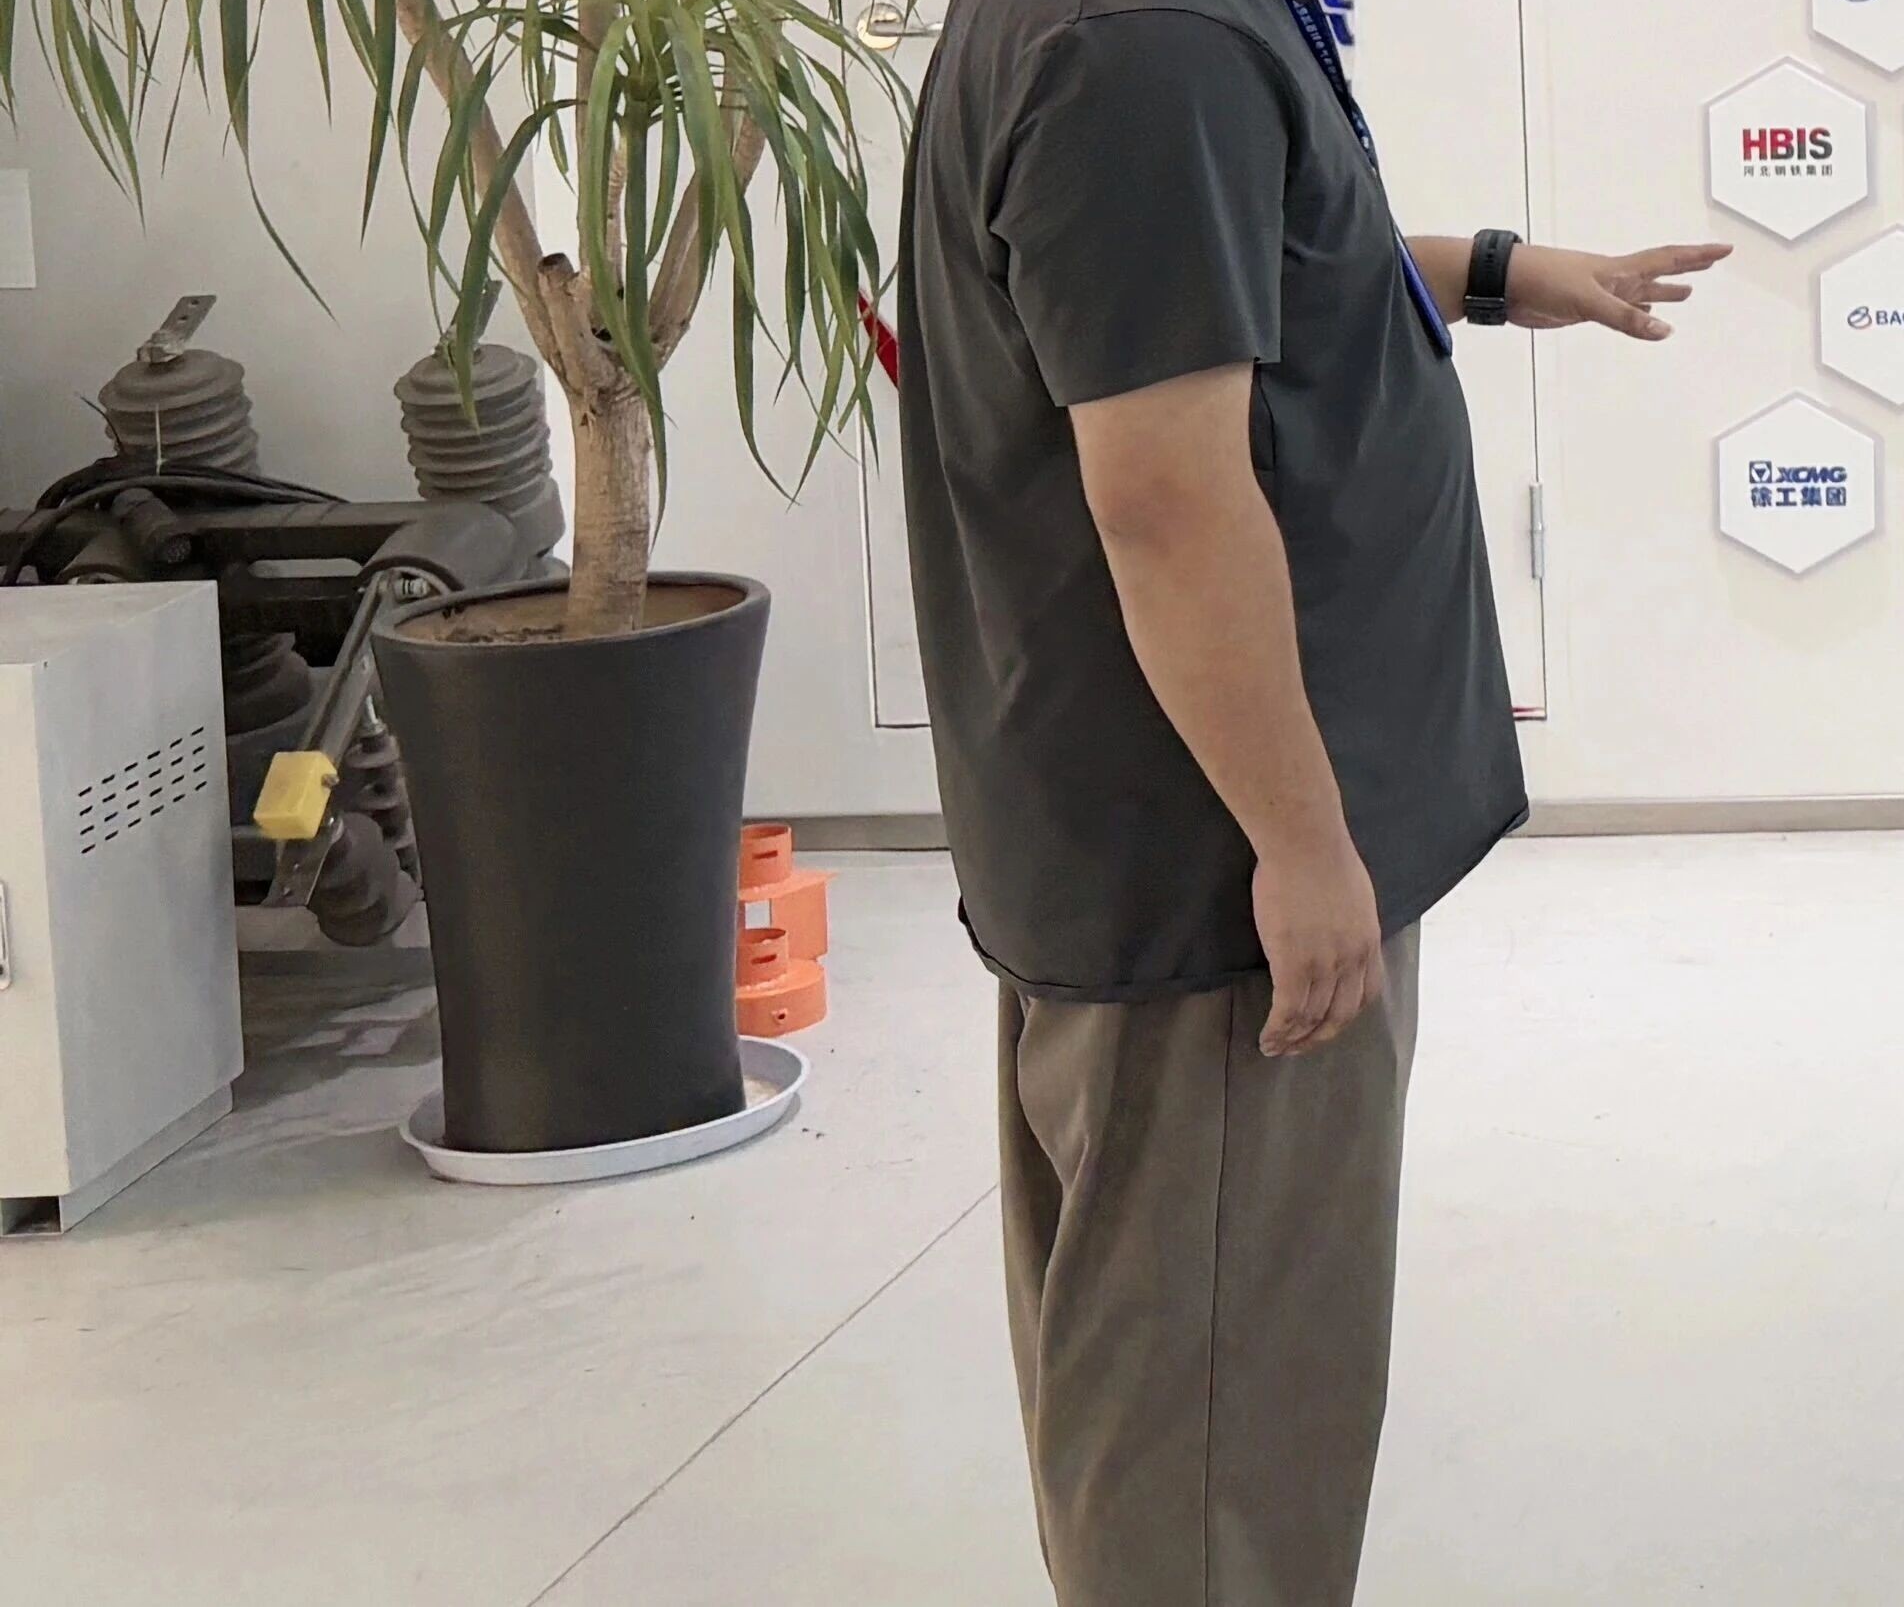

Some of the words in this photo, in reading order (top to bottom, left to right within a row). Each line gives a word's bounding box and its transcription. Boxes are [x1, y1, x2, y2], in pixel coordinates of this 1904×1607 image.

[1742, 127, 1833, 161] HBIS
[1743, 165, 1833, 178] 河北钢铁集团
[1775, 466, 1848, 484] XCMG
[1750, 485, 1847, 508] 徐工集团
